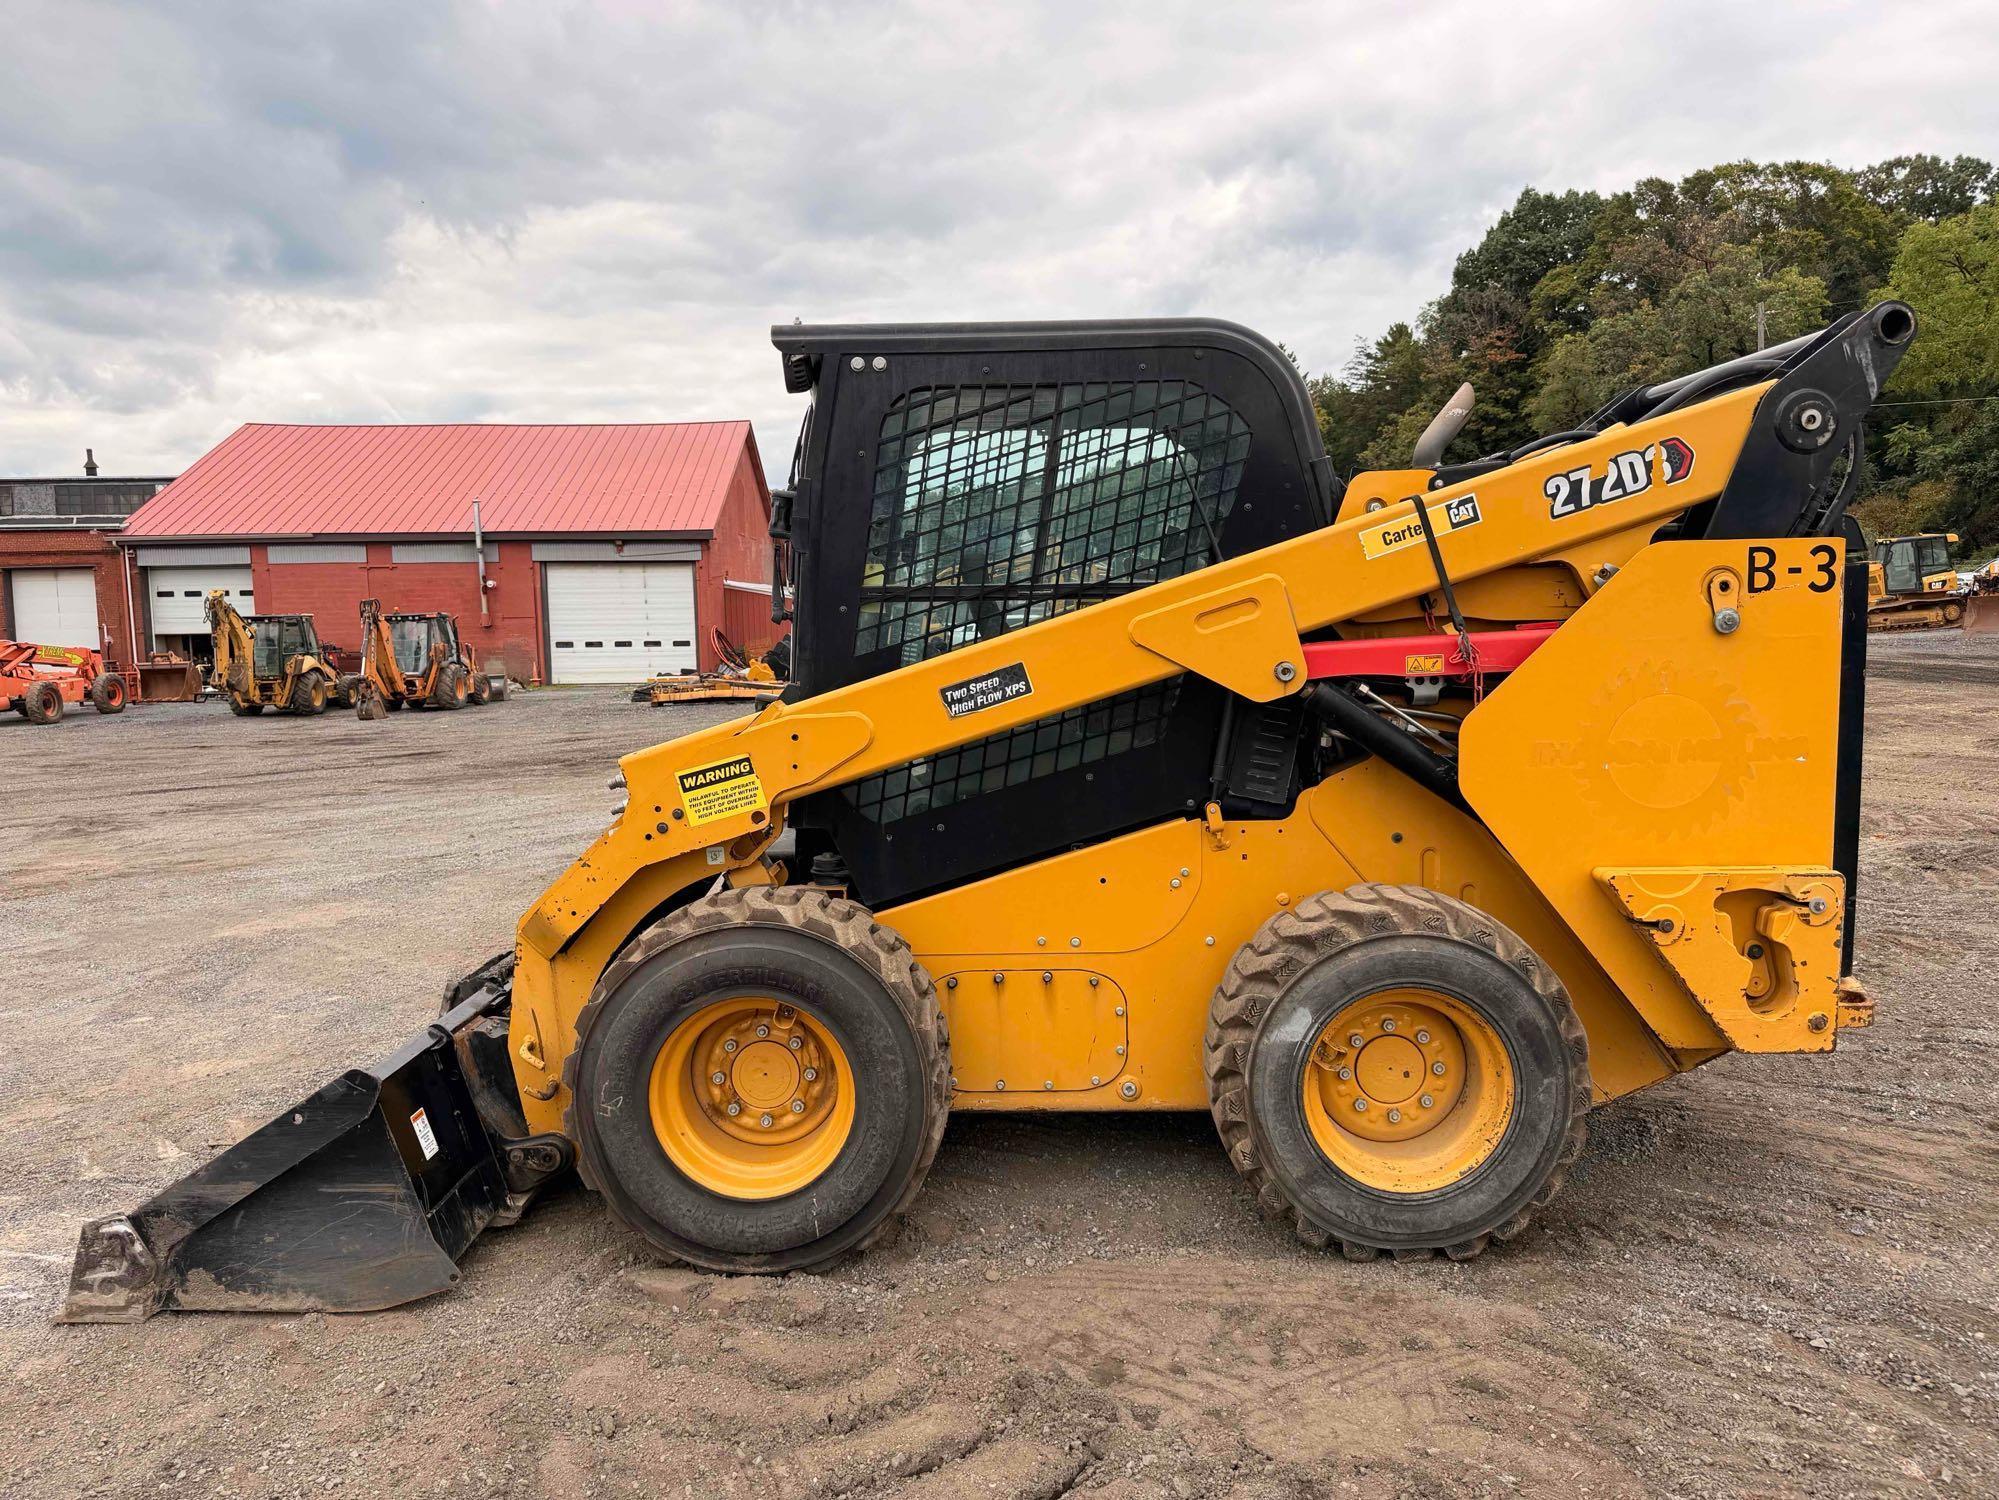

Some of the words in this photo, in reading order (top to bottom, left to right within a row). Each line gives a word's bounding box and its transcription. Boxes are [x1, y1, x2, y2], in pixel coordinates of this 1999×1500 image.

[1382, 524, 1423, 546] Carte
[1449, 502, 1475, 524] CAT
[1748, 544, 1837, 594] B-3
[1931, 581, 1943, 589] CAT
[1005, 681, 1026, 698] XPS
[683, 762, 750, 789] WARNING
[688, 791, 719, 803] UNLAWFUL
[730, 781, 755, 791] OPERATE
[704, 792, 737, 805] EQUIPMENT
[738, 786, 759, 795] WITHIN
[727, 793, 757, 805] OVERHEAD
[714, 804, 738, 814] VOLTAGE
[740, 799, 757, 807] LINES
